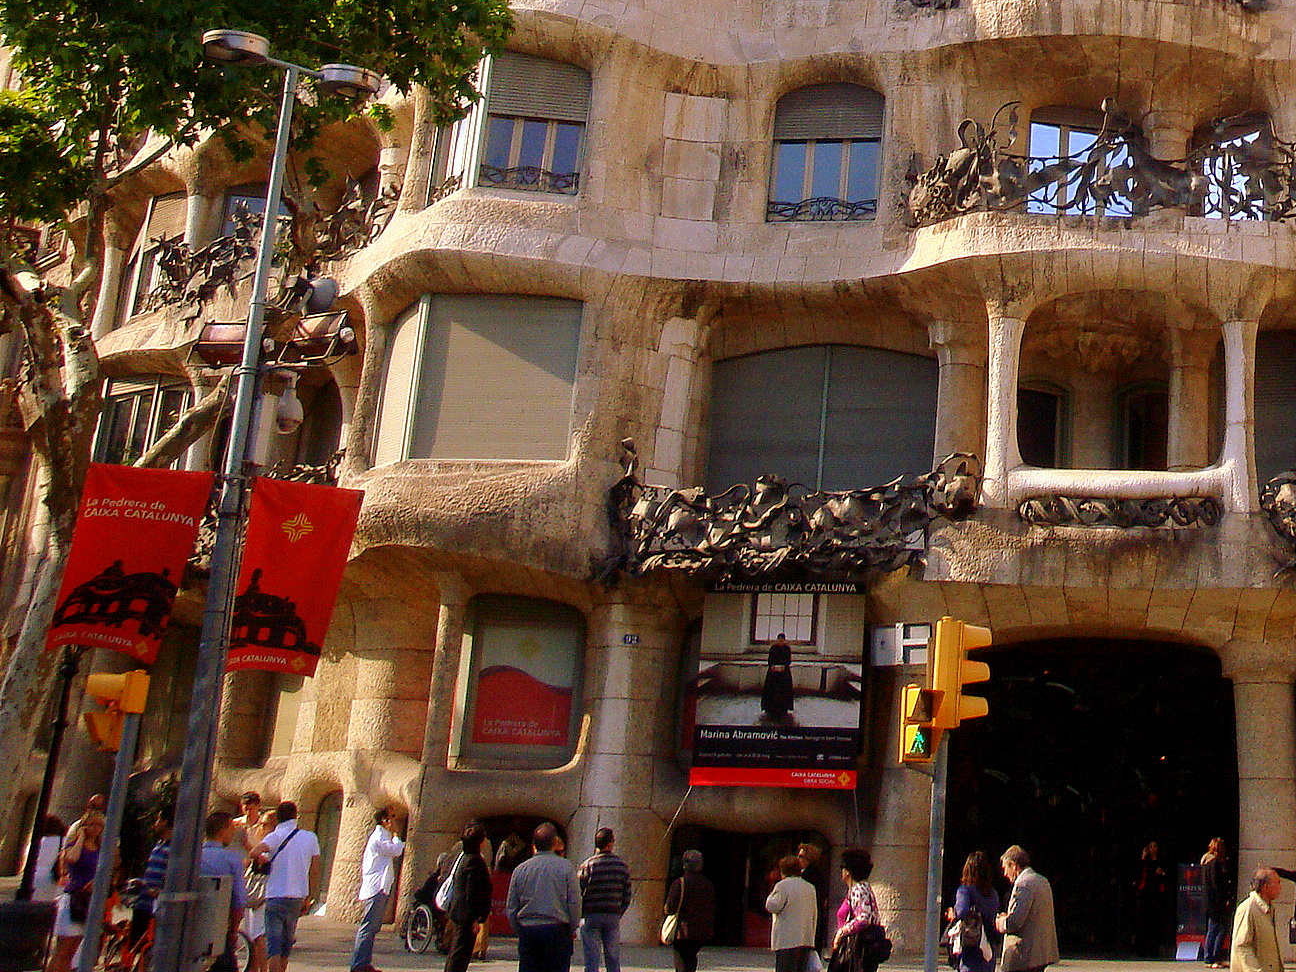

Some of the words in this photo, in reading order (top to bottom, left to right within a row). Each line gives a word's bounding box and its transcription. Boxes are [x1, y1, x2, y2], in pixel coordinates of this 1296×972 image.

[86, 498, 99, 507] La
[101, 497, 147, 509] Pedrera
[150, 501, 166, 511] de
[84, 508, 119, 518] CAIXA
[124, 509, 194, 527] CATALUNYA
[761, 583, 773, 591] de
[774, 583, 802, 592] CAIXA
[804, 583, 857, 592] CATALUNYA
[241, 654, 288, 665] CATALUNYA
[700, 729, 730, 739] Marina
[732, 730, 778, 740] Abramović
